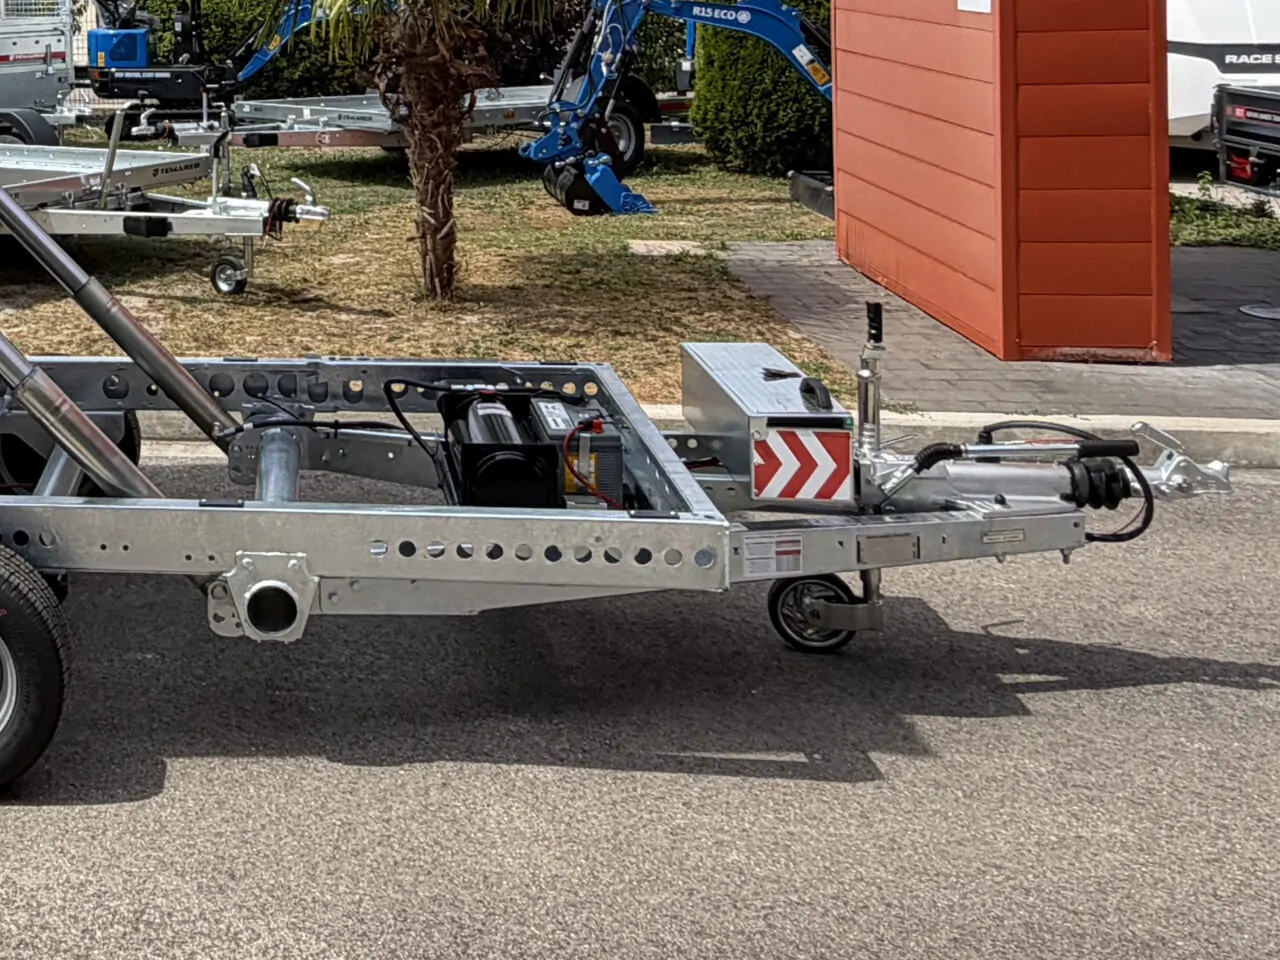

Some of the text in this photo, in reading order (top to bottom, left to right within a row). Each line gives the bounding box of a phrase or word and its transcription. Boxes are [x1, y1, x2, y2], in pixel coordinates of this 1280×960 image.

[692, 6, 736, 21] R15 ECO
[1225, 54, 1273, 64] RACE
